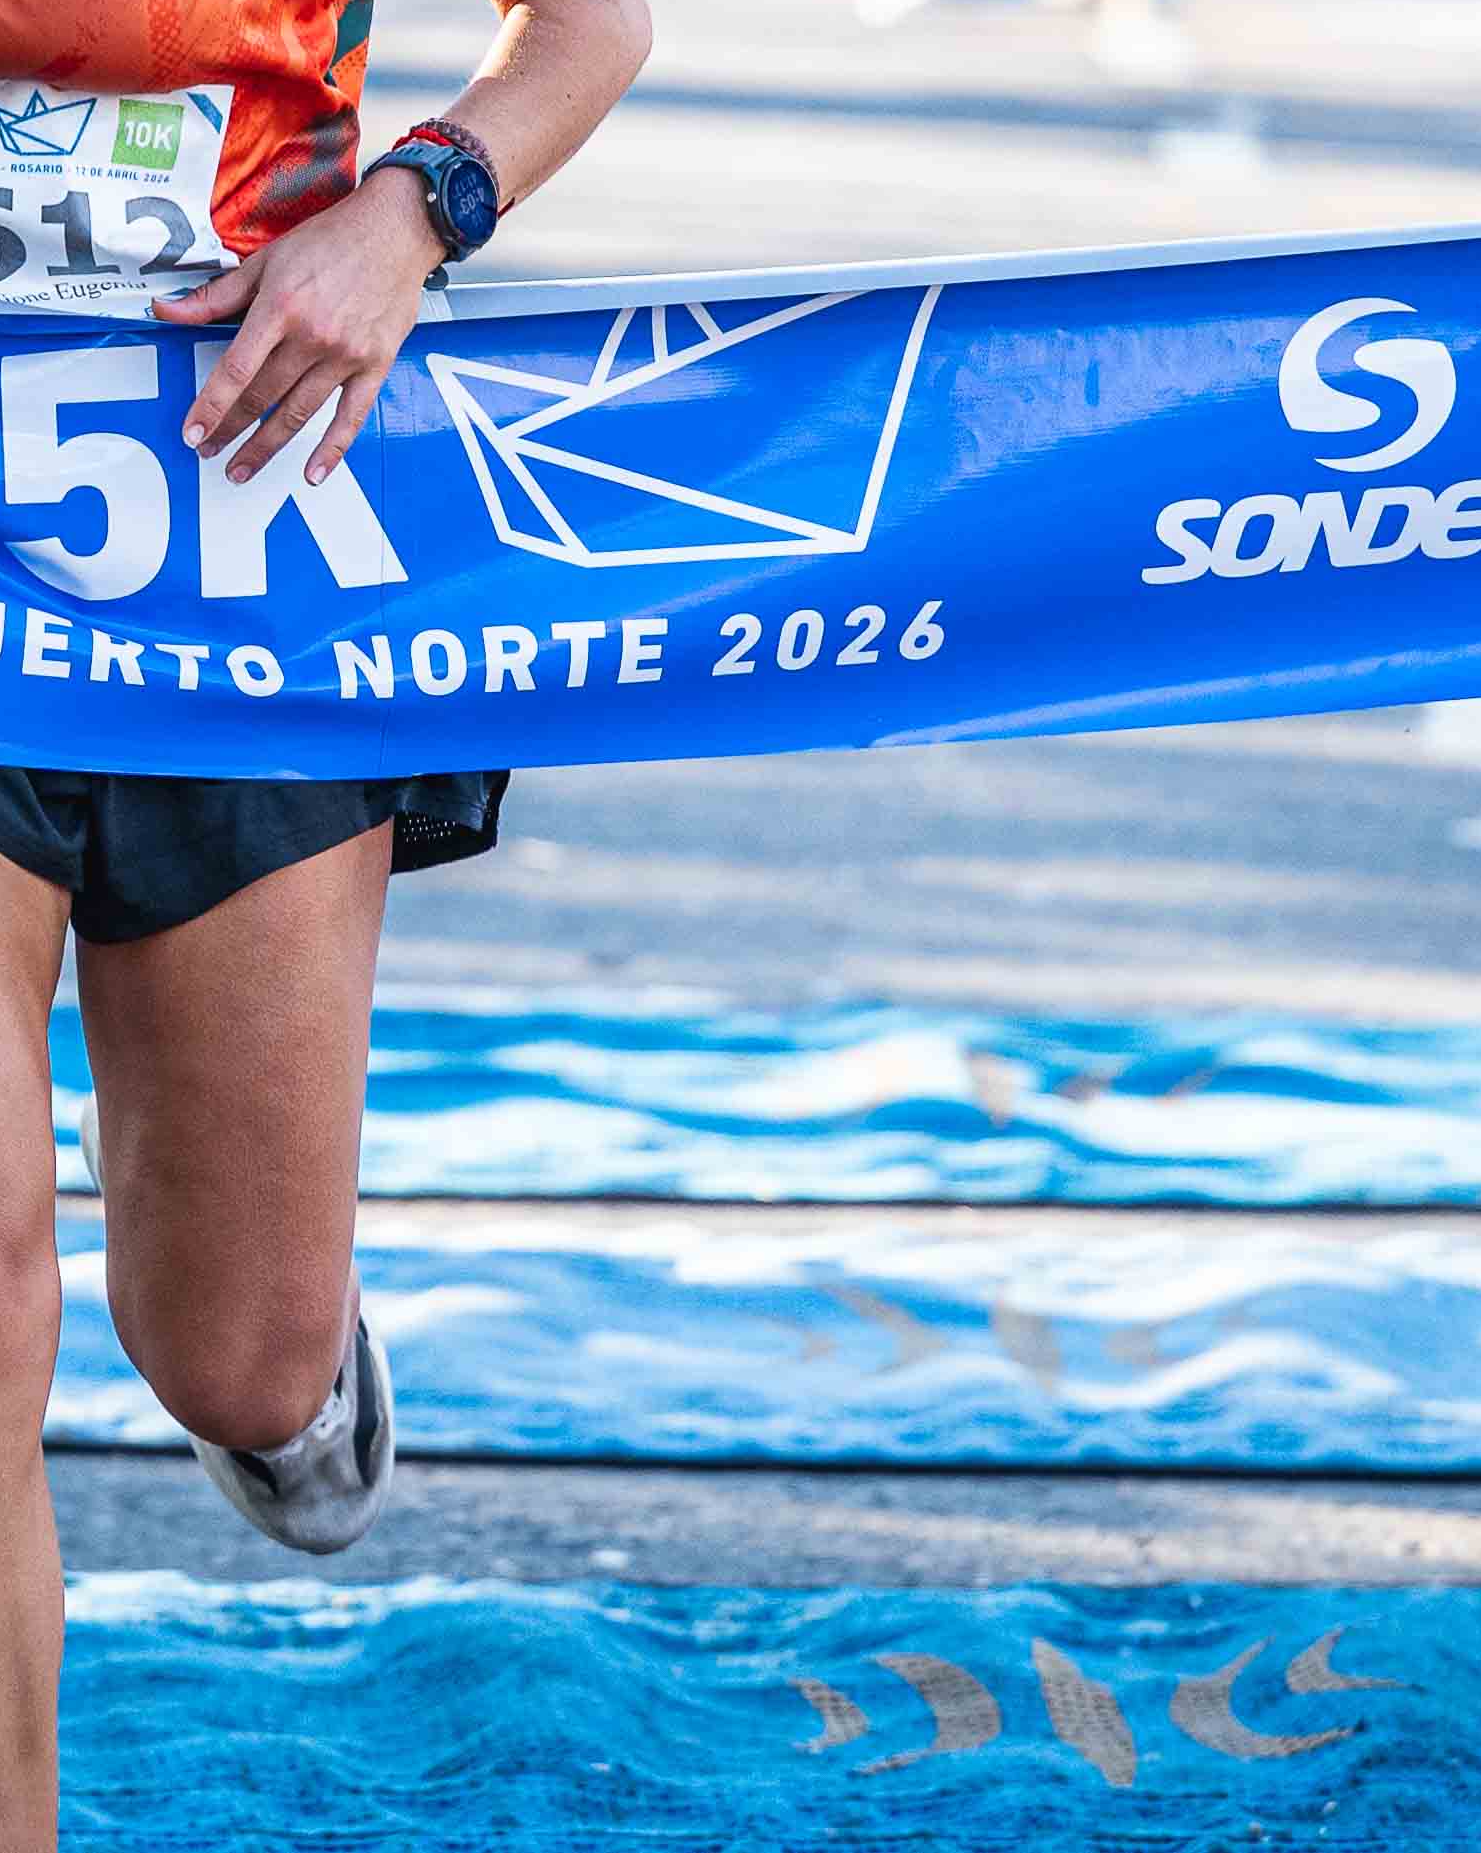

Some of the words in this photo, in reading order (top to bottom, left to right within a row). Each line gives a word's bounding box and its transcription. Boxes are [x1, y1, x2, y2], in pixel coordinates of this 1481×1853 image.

[122, 119, 175, 151] 10K
[10, 163, 63, 174] ROSARIO
[332, 617, 670, 700] NORTE
[711, 600, 945, 678] 2026
